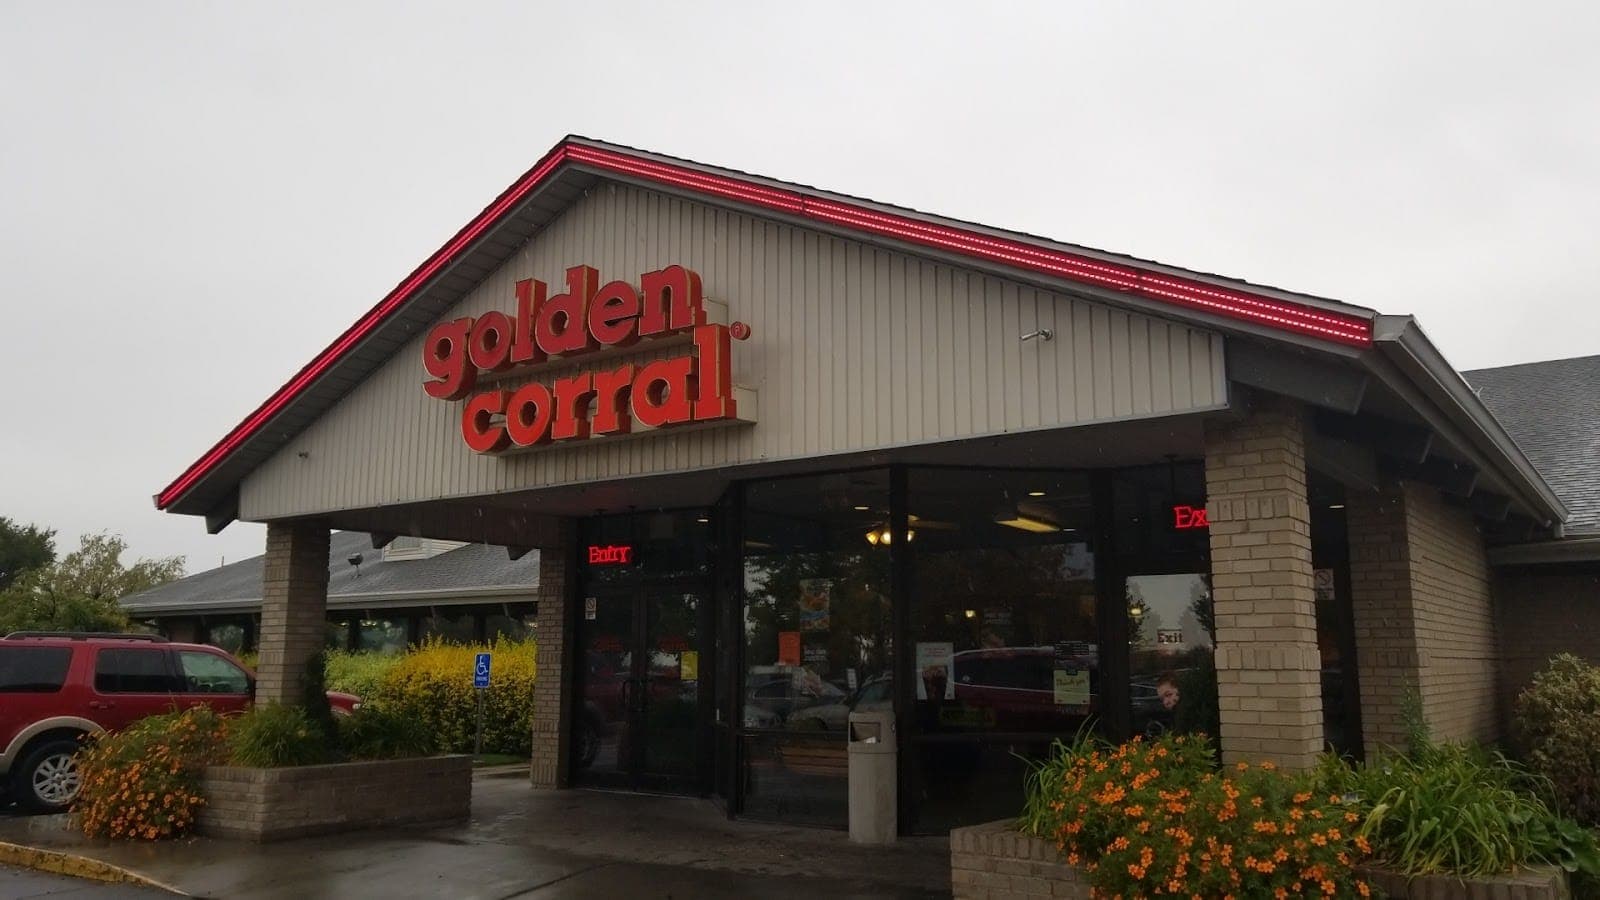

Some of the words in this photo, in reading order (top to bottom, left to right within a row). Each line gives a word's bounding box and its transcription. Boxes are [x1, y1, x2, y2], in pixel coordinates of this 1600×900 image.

[423, 264, 704, 400] golden
[461, 323, 734, 452] corral
[1173, 505, 1208, 528] Ex
[588, 545, 631, 564] Entry
[1157, 632, 1183, 643] Exit
